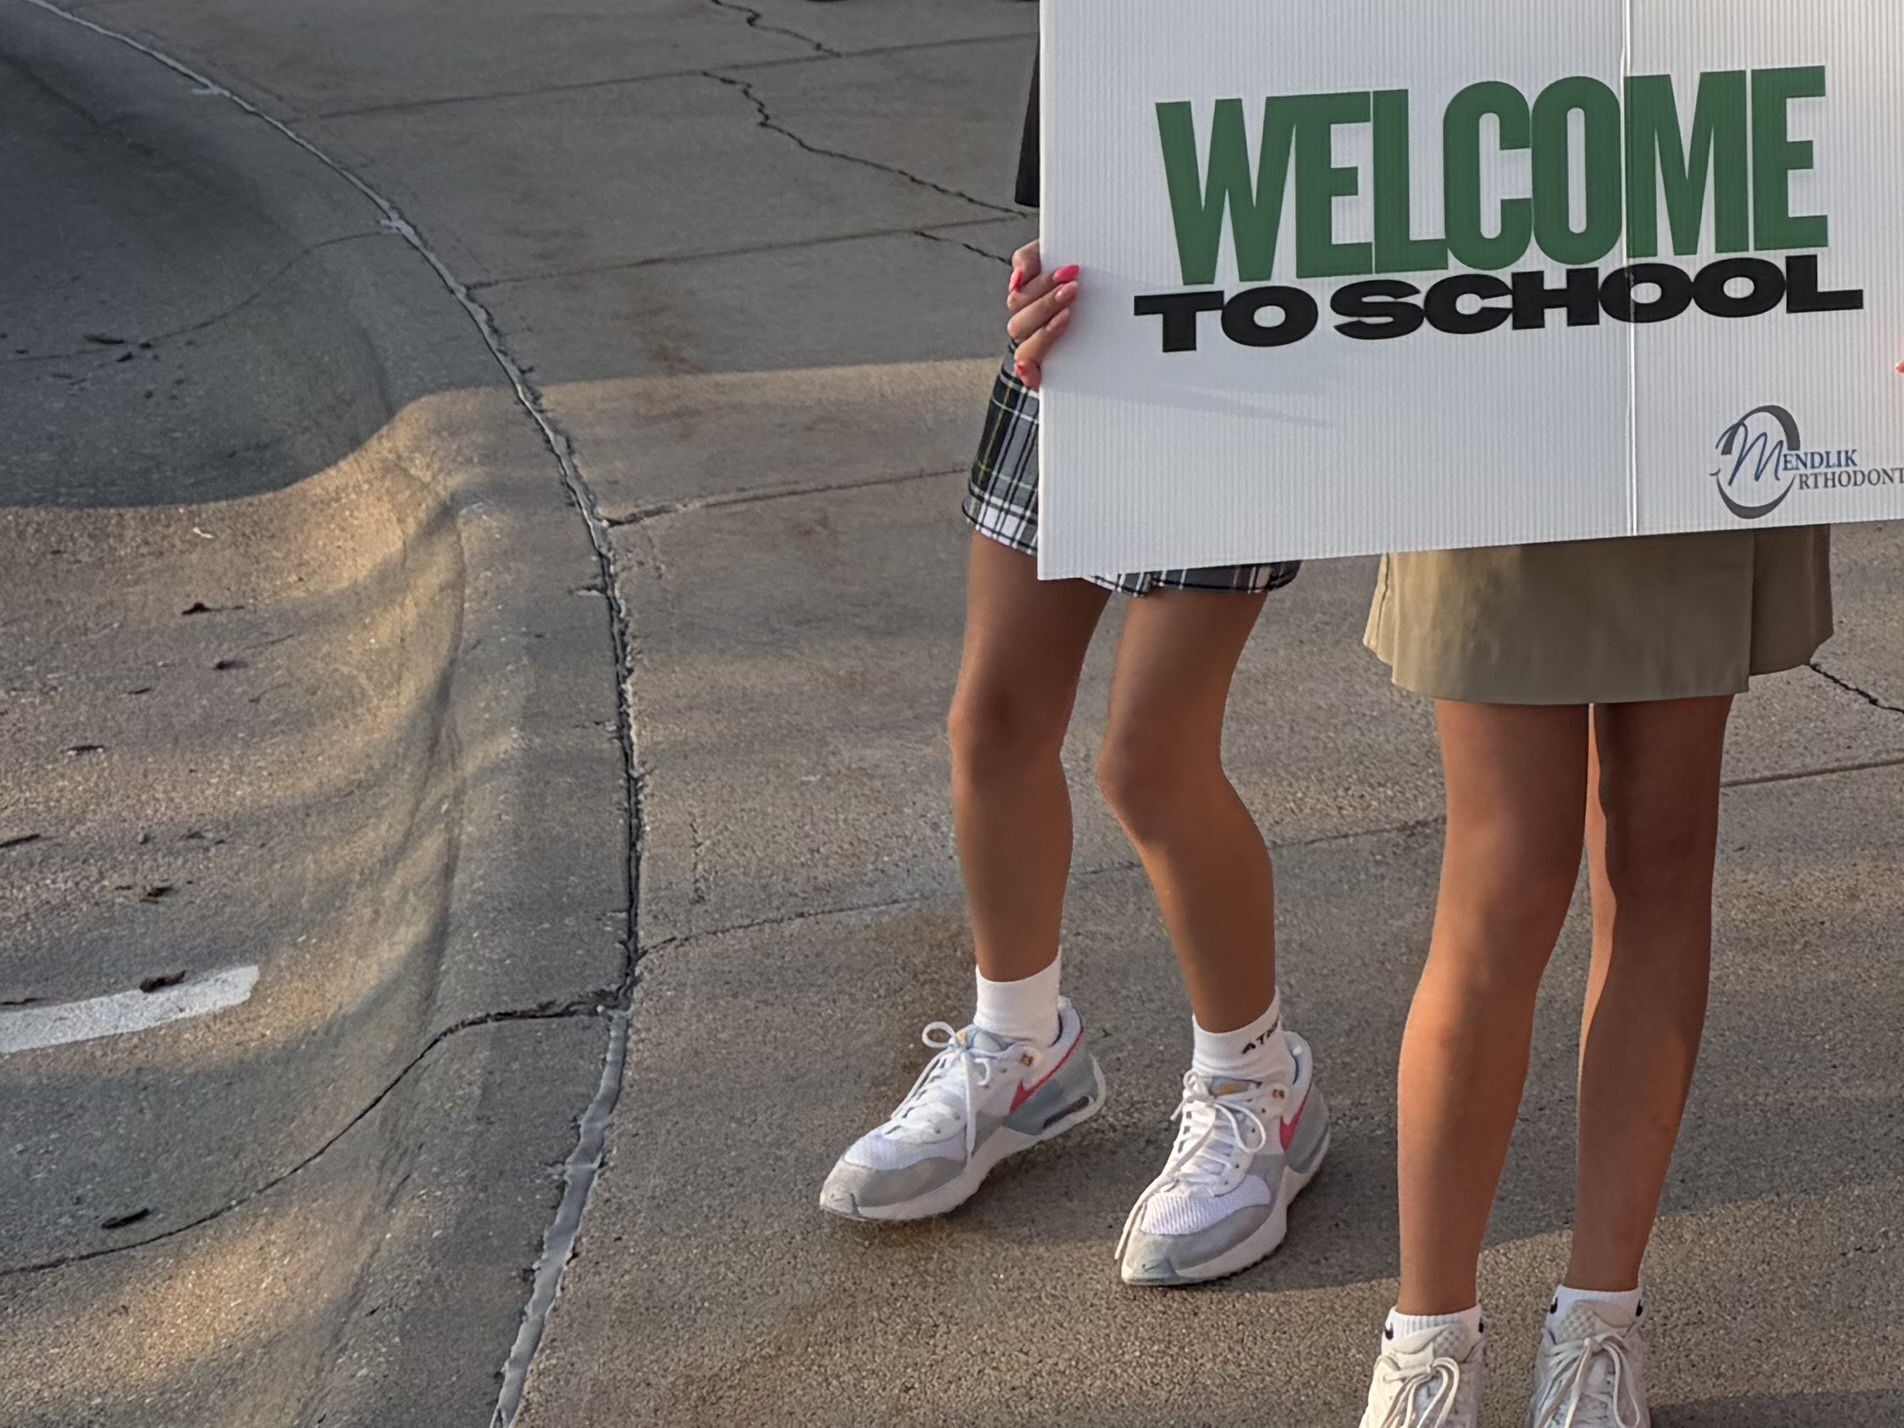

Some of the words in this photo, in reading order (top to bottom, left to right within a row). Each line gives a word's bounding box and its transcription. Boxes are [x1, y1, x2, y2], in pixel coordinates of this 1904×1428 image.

[1156, 66, 1828, 286] WELCOME
[1134, 285, 1319, 353] TO
[1330, 256, 1864, 340] SCHOOL
[1715, 421, 1858, 486] MENDLIK
